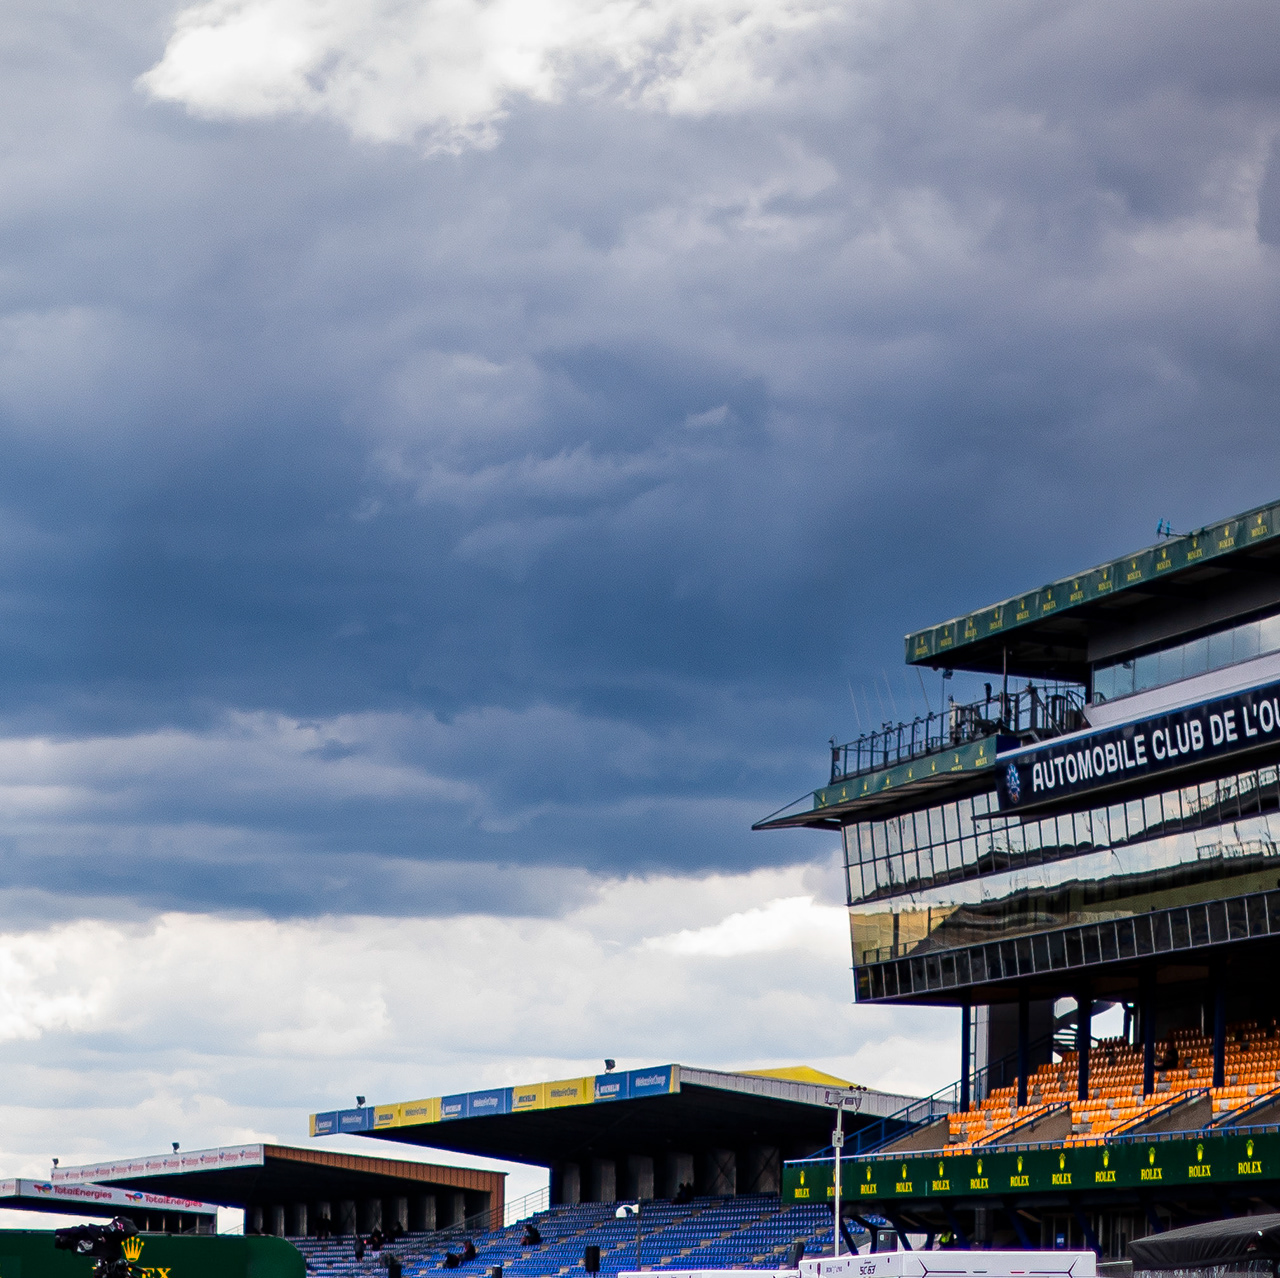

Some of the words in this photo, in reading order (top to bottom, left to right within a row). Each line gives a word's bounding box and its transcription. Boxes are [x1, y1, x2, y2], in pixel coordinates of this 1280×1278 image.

[1032, 734, 1146, 793] AUTOMOBILE
[1152, 719, 1204, 761] CLUB
[1209, 709, 1238, 745] DE
[1140, 1168, 1162, 1180] ROLEX
[1188, 1165, 1211, 1178] ROLEX
[1237, 1161, 1262, 1175] ROLEX
[1010, 1175, 1029, 1187] ROLEX
[1051, 1173, 1072, 1185] ROLEX
[1095, 1170, 1116, 1183] ROLEX
[860, 1183, 877, 1194] ROLEX
[895, 1181, 912, 1193] ROLEX
[932, 1179, 950, 1191] ROLEX
[970, 1177, 989, 1189] ROLEX
[54, 1185, 113, 1199] TotalEnergies
[794, 1187, 810, 1198] ROLEX
[144, 1193, 204, 1208] TotalEnergies
